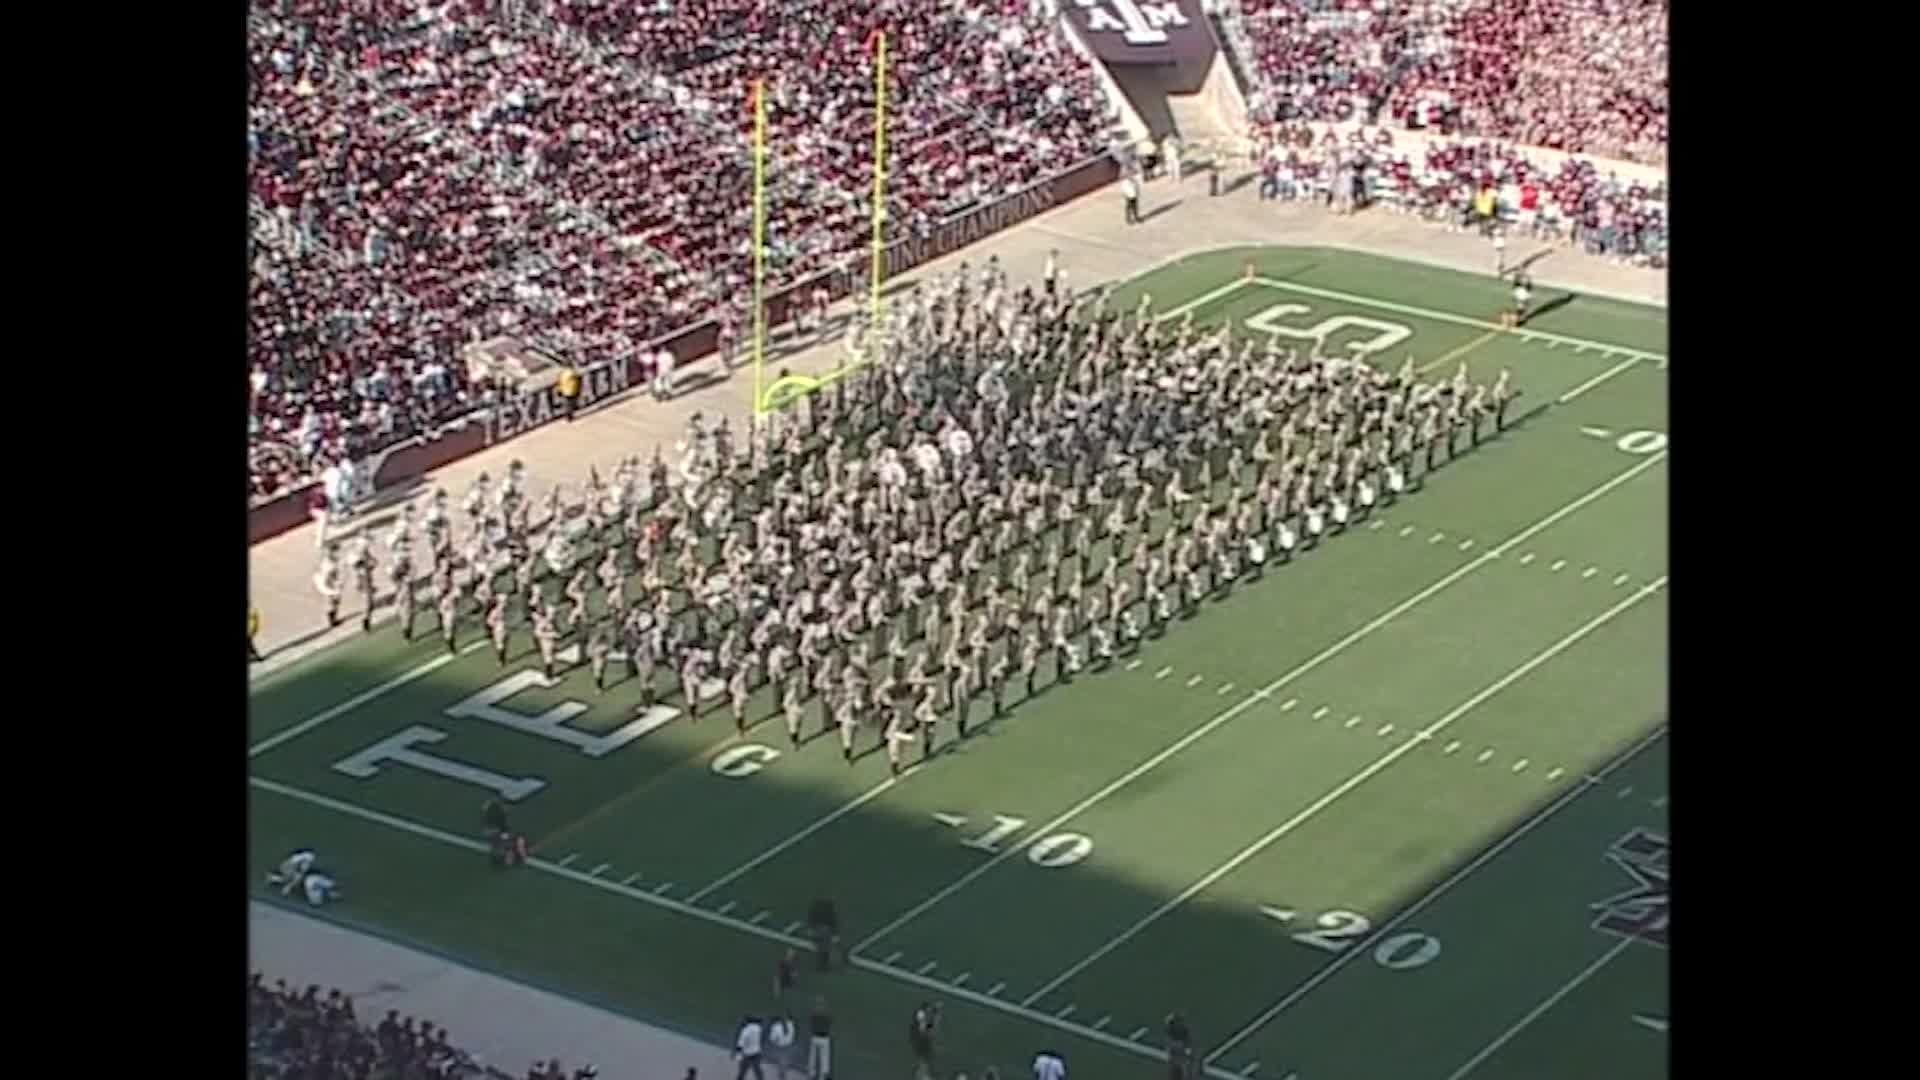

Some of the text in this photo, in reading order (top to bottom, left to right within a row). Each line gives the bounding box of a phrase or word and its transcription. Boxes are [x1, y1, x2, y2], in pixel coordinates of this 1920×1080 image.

[937, 186, 1054, 250] CHAMPIONS
[484, 386, 568, 444] TEXAS
[961, 814, 1093, 868] 10
[1292, 911, 1440, 969] 20
